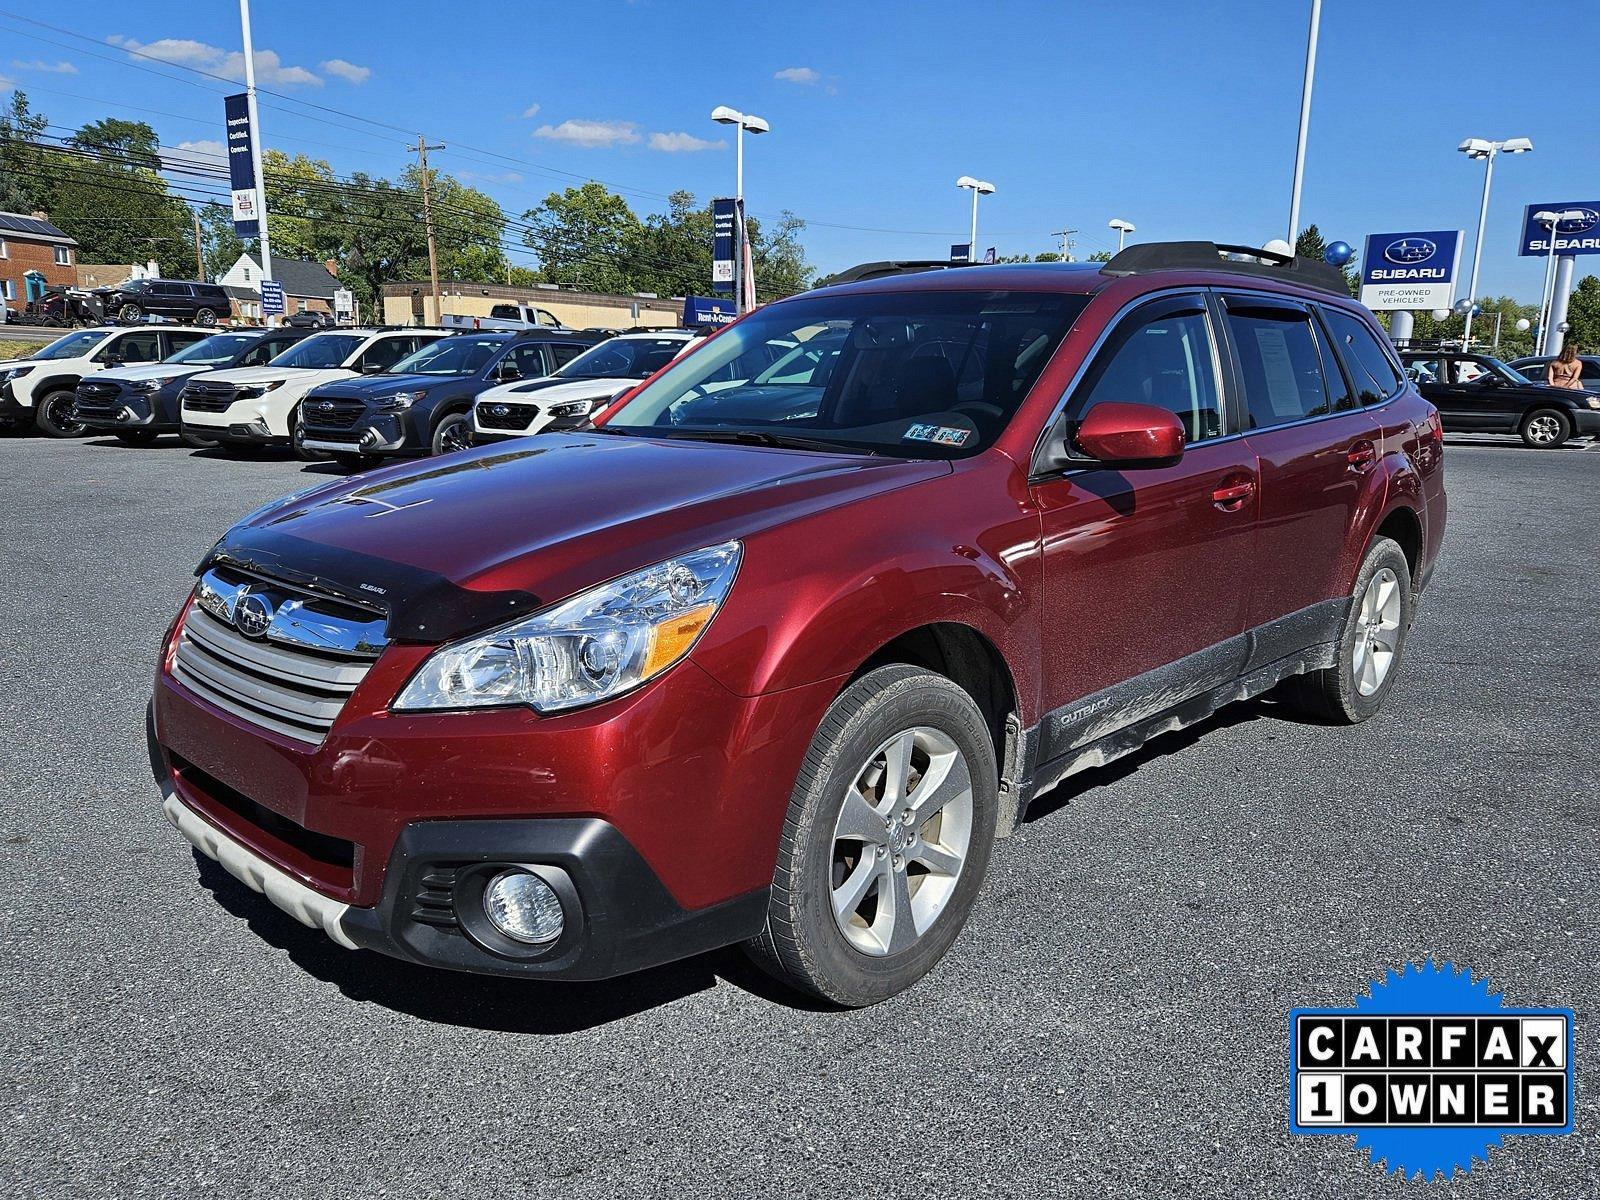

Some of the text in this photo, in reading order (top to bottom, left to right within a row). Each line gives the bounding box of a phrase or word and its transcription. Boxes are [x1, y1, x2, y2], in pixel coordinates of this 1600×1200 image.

[1371, 268, 1446, 279] SUBARU
[1378, 289, 1431, 297] PRE-OWNED
[360, 583, 387, 595] SUBARU
[1060, 696, 1115, 726] OUTBACK
